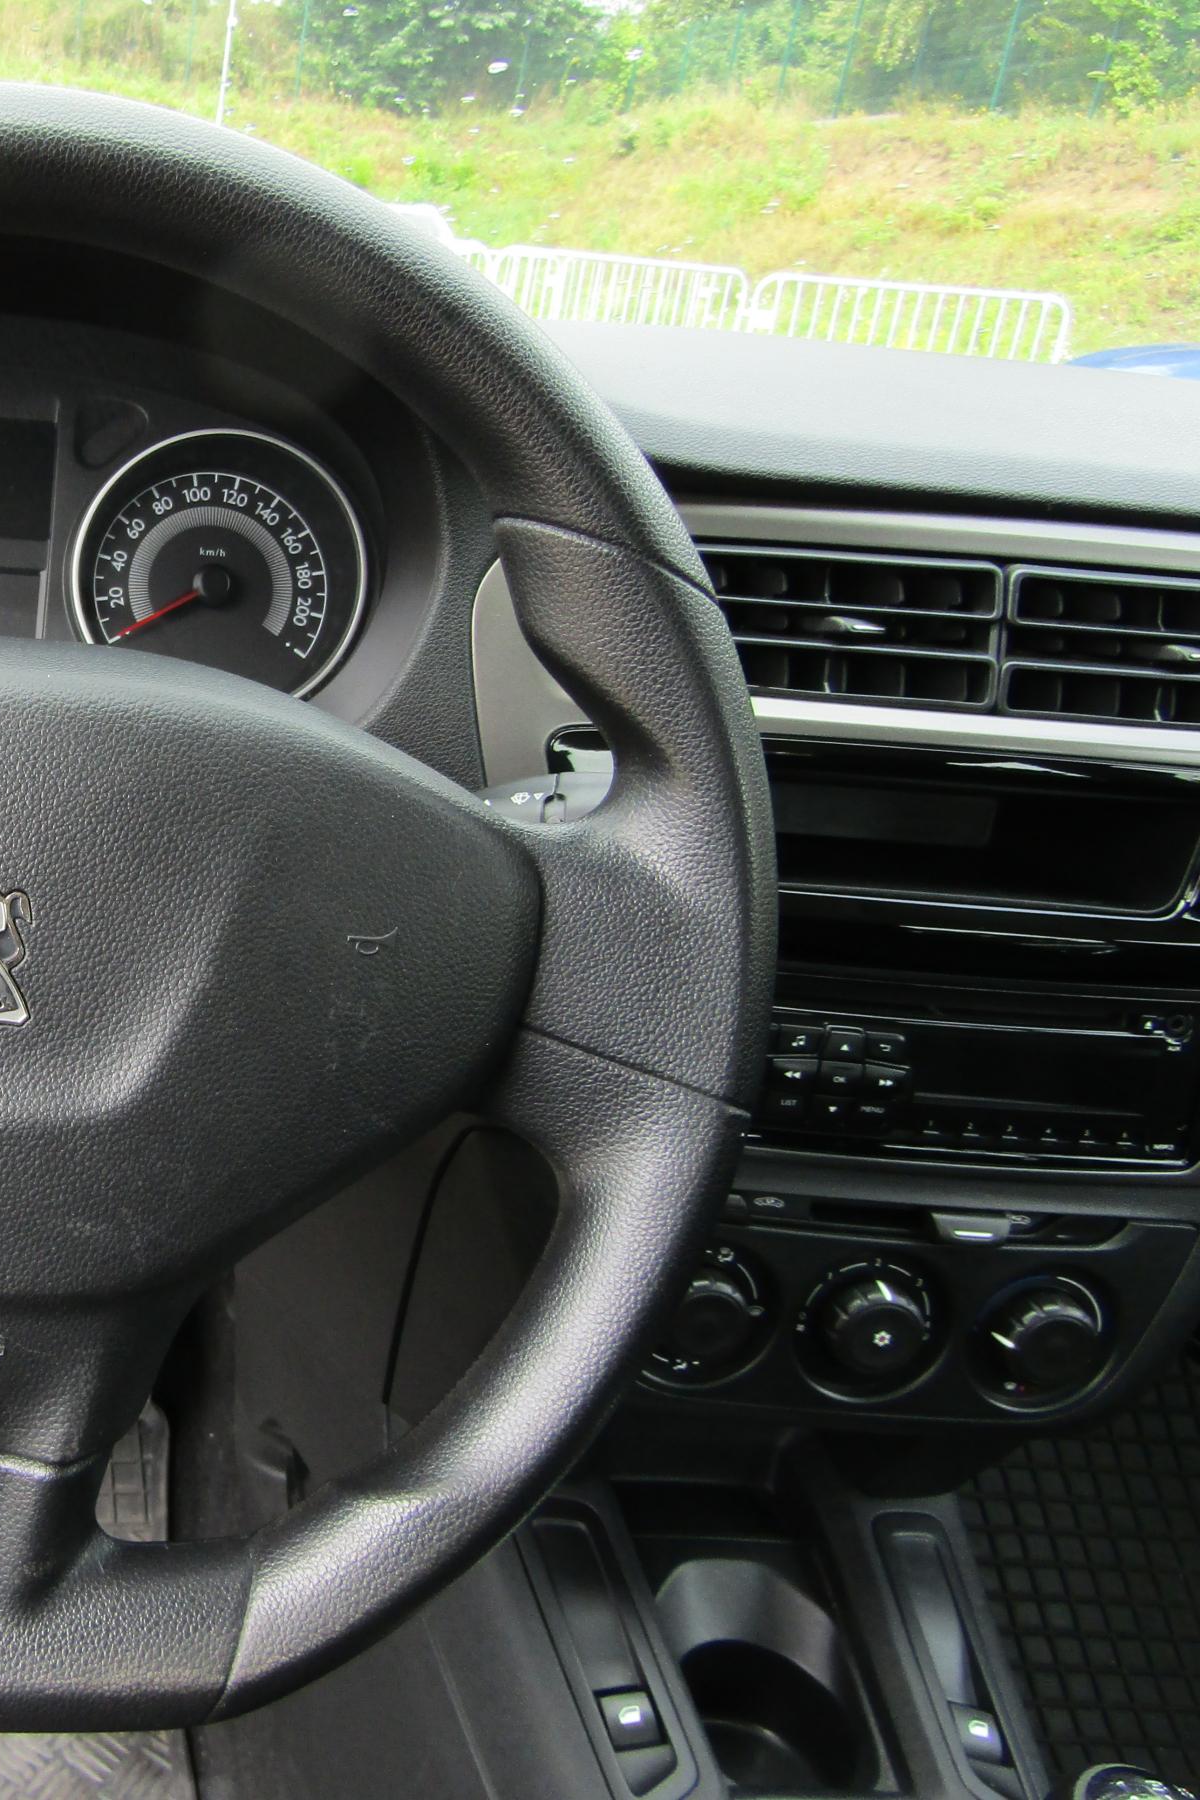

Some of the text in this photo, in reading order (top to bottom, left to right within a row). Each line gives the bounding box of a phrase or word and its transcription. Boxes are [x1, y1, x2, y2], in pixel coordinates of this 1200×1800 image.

[151, 496, 174, 516] 80
[181, 487, 212, 503] 100
[221, 488, 249, 508] 120
[255, 502, 280, 527] 140
[126, 518, 146, 539] 60
[279, 527, 303, 555] 160
[111, 550, 128, 573] 40
[199, 547, 227, 558] km/h
[295, 563, 312, 590] 180
[109, 586, 125, 608] 20
[292, 597, 312, 628] 200
